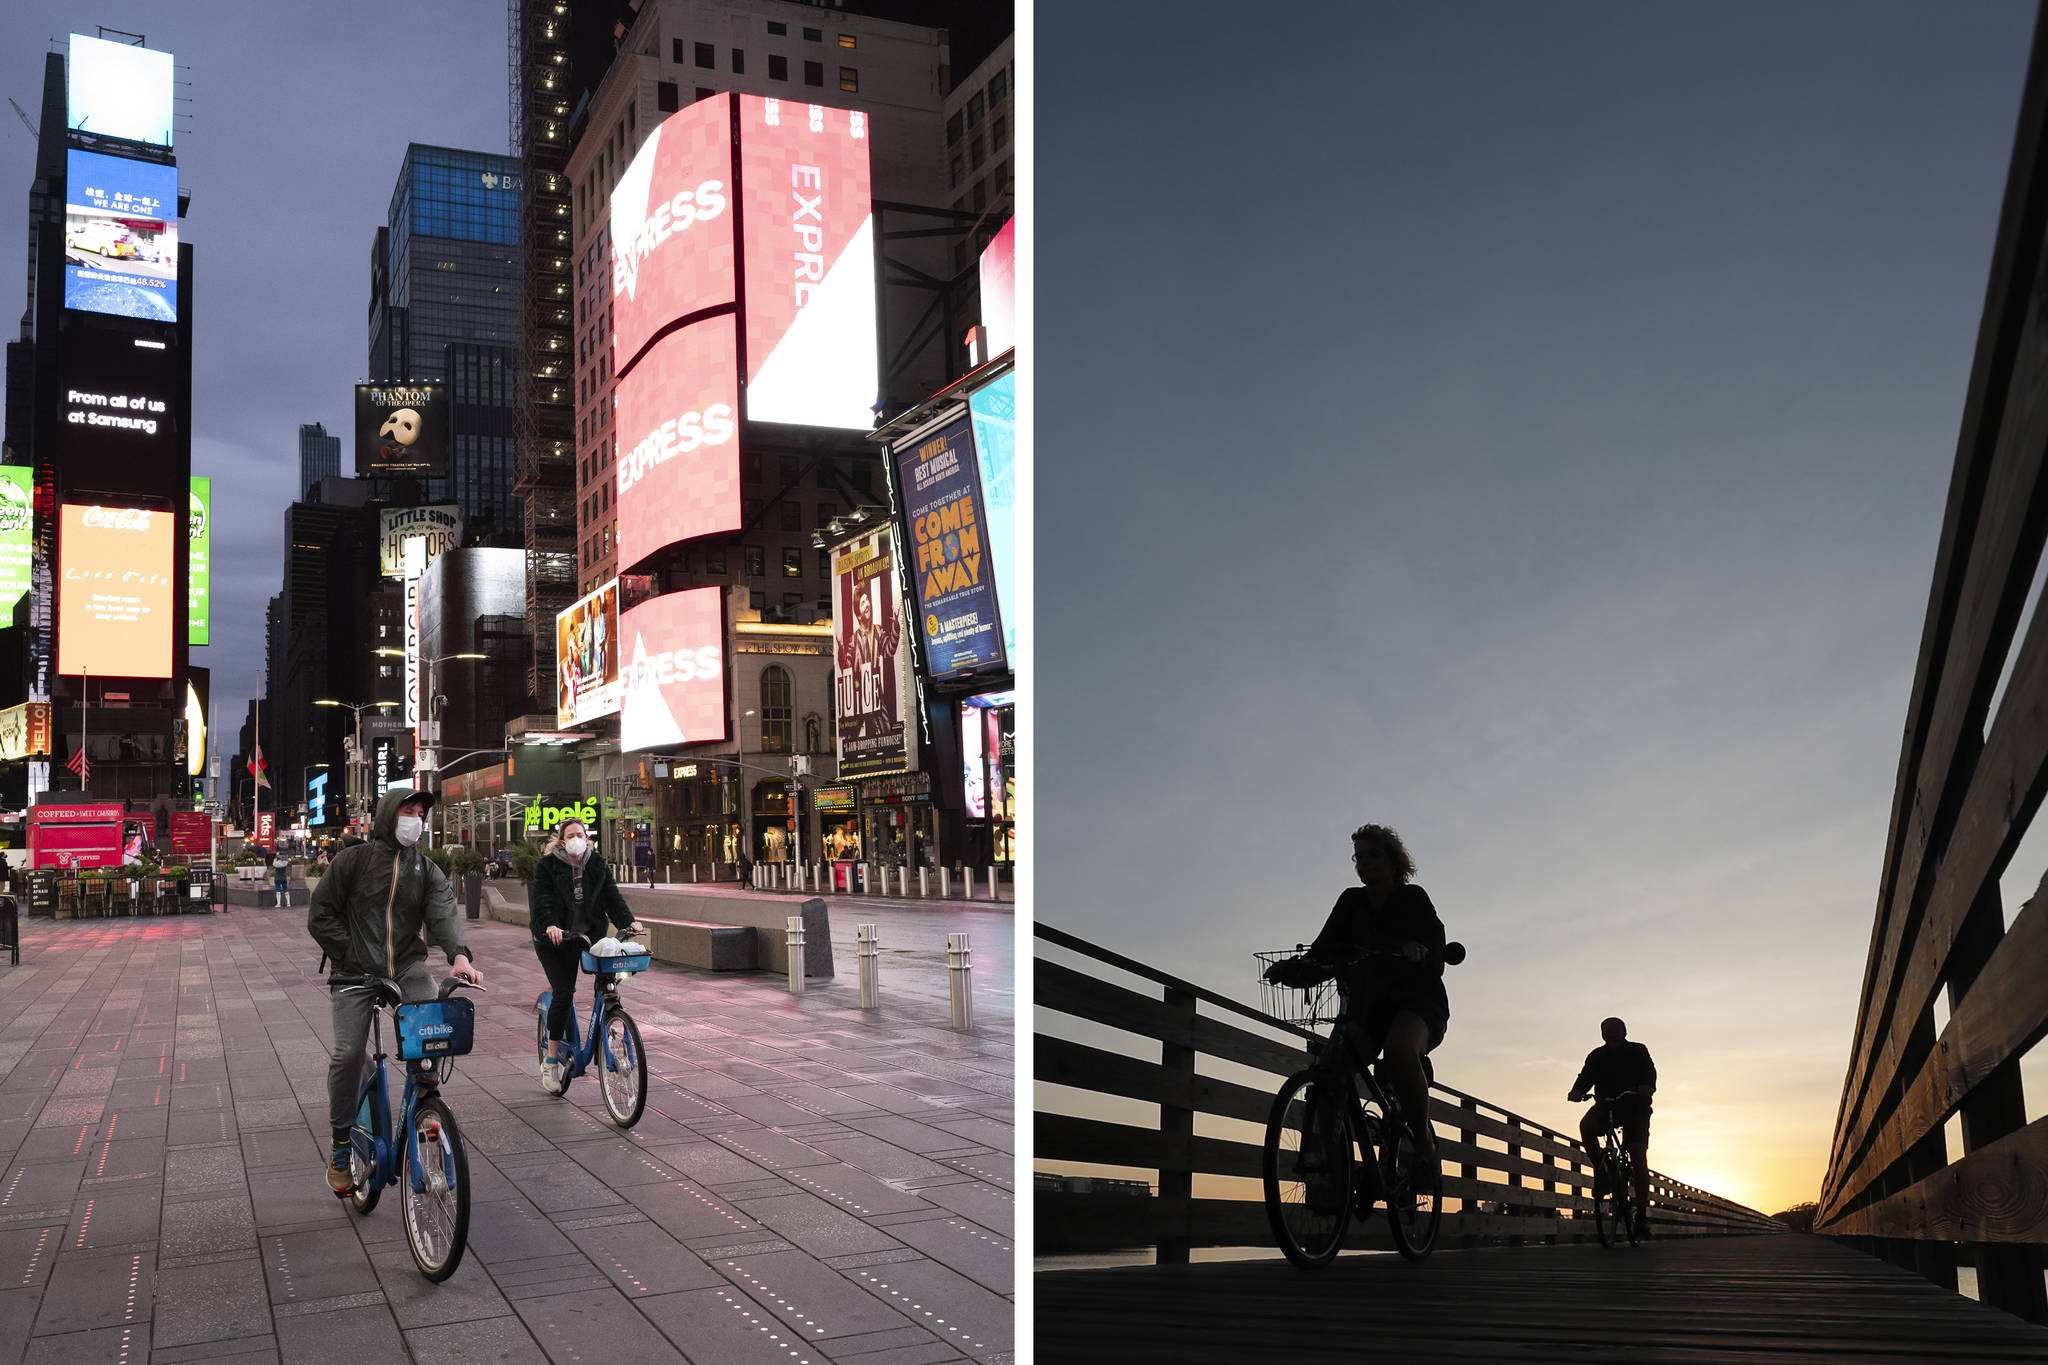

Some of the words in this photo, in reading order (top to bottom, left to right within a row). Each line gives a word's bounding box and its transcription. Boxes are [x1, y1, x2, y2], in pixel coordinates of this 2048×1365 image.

[93, 198, 108, 208] WE
[111, 201, 130, 211] ARE
[132, 205, 153, 215] ONE
[68, 390, 107, 406] From
[109, 395, 127, 408] all
[129, 397, 146, 410] of
[148, 400, 166, 412] us
[370, 391, 431, 401] PHANTOM
[68, 411, 86, 424] at
[88, 412, 157, 434] Samsung
[618, 402, 734, 496] EXPRESS
[919, 435, 948, 463] WINNER!
[914, 461, 930, 483] BEST
[930, 447, 958, 475] MUSICAL
[912, 505, 929, 518] COME
[929, 489, 961, 510] TOGETHER
[962, 485, 971, 495] AT
[389, 509, 426, 531] LITTLE
[429, 510, 456, 528] SHOP
[915, 495, 975, 544] COME
[388, 531, 456, 568] HOORS
[924, 552, 981, 601] AWAY
[34, 705, 46, 753] HELLO!
[673, 764, 698, 780] EXPRESS
[37, 810, 76, 818] COFFEED
[261, 814, 272, 836] tkts
[543, 796, 597, 830] pelé
